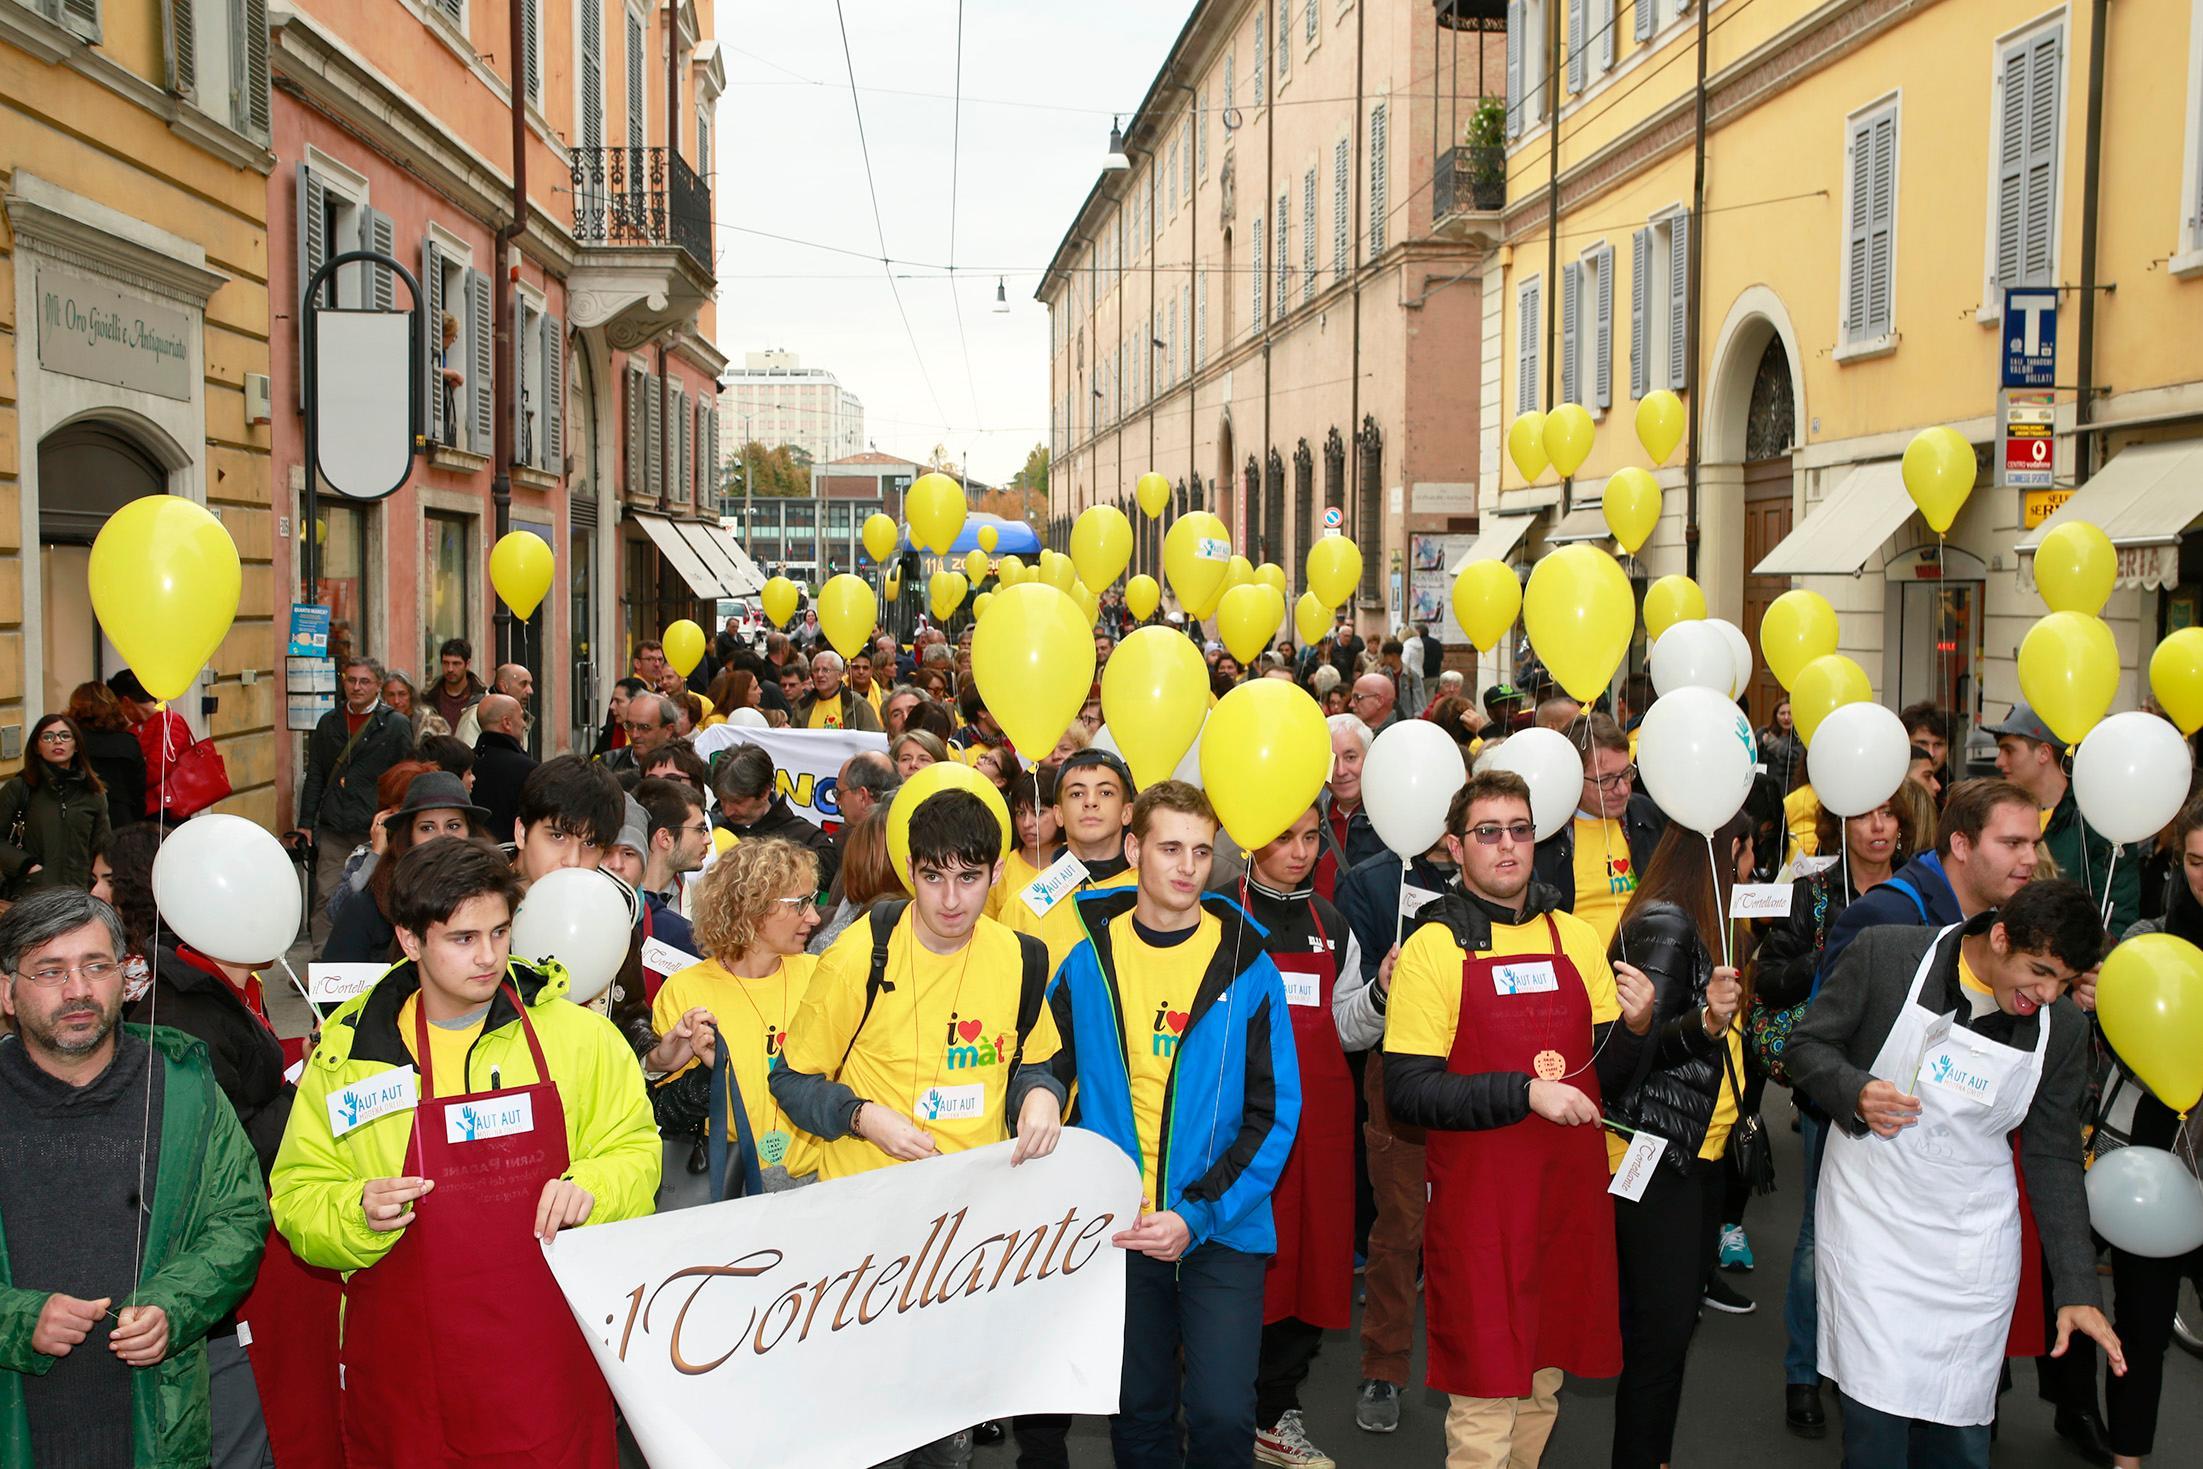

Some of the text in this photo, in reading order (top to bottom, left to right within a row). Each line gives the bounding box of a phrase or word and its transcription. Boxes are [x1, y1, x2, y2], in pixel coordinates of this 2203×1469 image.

[65, 299, 87, 332] Oro
[88, 307, 121, 346] Gioielli
[122, 327, 128, 344] e
[129, 319, 187, 363] Antiquariato
[2010, 295, 2056, 356] T
[1046, 876, 1062, 893] AUT
[1060, 864, 1076, 881] AUT
[1285, 984, 1311, 995] UT AUT
[1516, 973, 1548, 986] AUT AUT
[1947, 1068, 1989, 1091] AUT AUT
[359, 1084, 402, 1112] AUT AUT
[940, 1097, 976, 1112] AUT AUT
[476, 1110, 521, 1130] AUT AUT
[642, 1206, 1115, 1376] Tortellante
